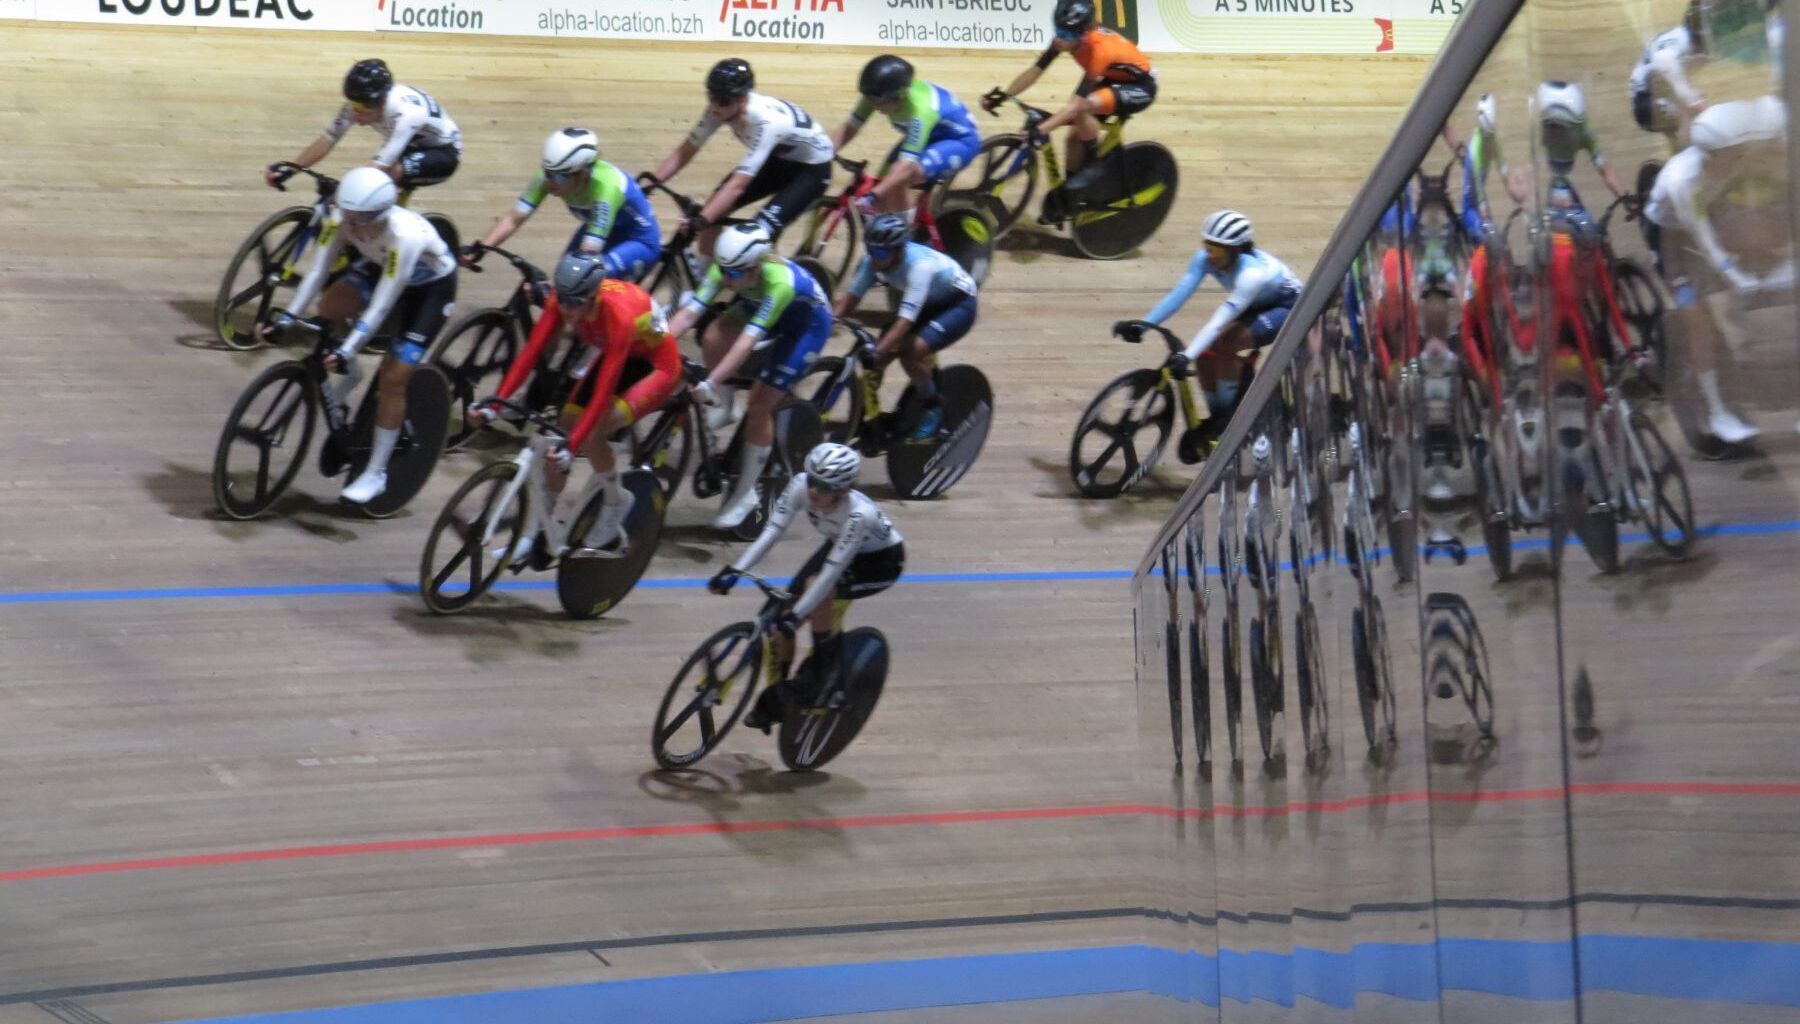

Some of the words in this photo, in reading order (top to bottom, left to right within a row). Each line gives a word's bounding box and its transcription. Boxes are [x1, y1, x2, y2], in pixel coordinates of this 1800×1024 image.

[390, 0, 484, 29] Location
[538, 7, 704, 36] alpha-location.bzh
[732, 13, 825, 39] Location
[878, 19, 1044, 44] alpha-location.bzh
